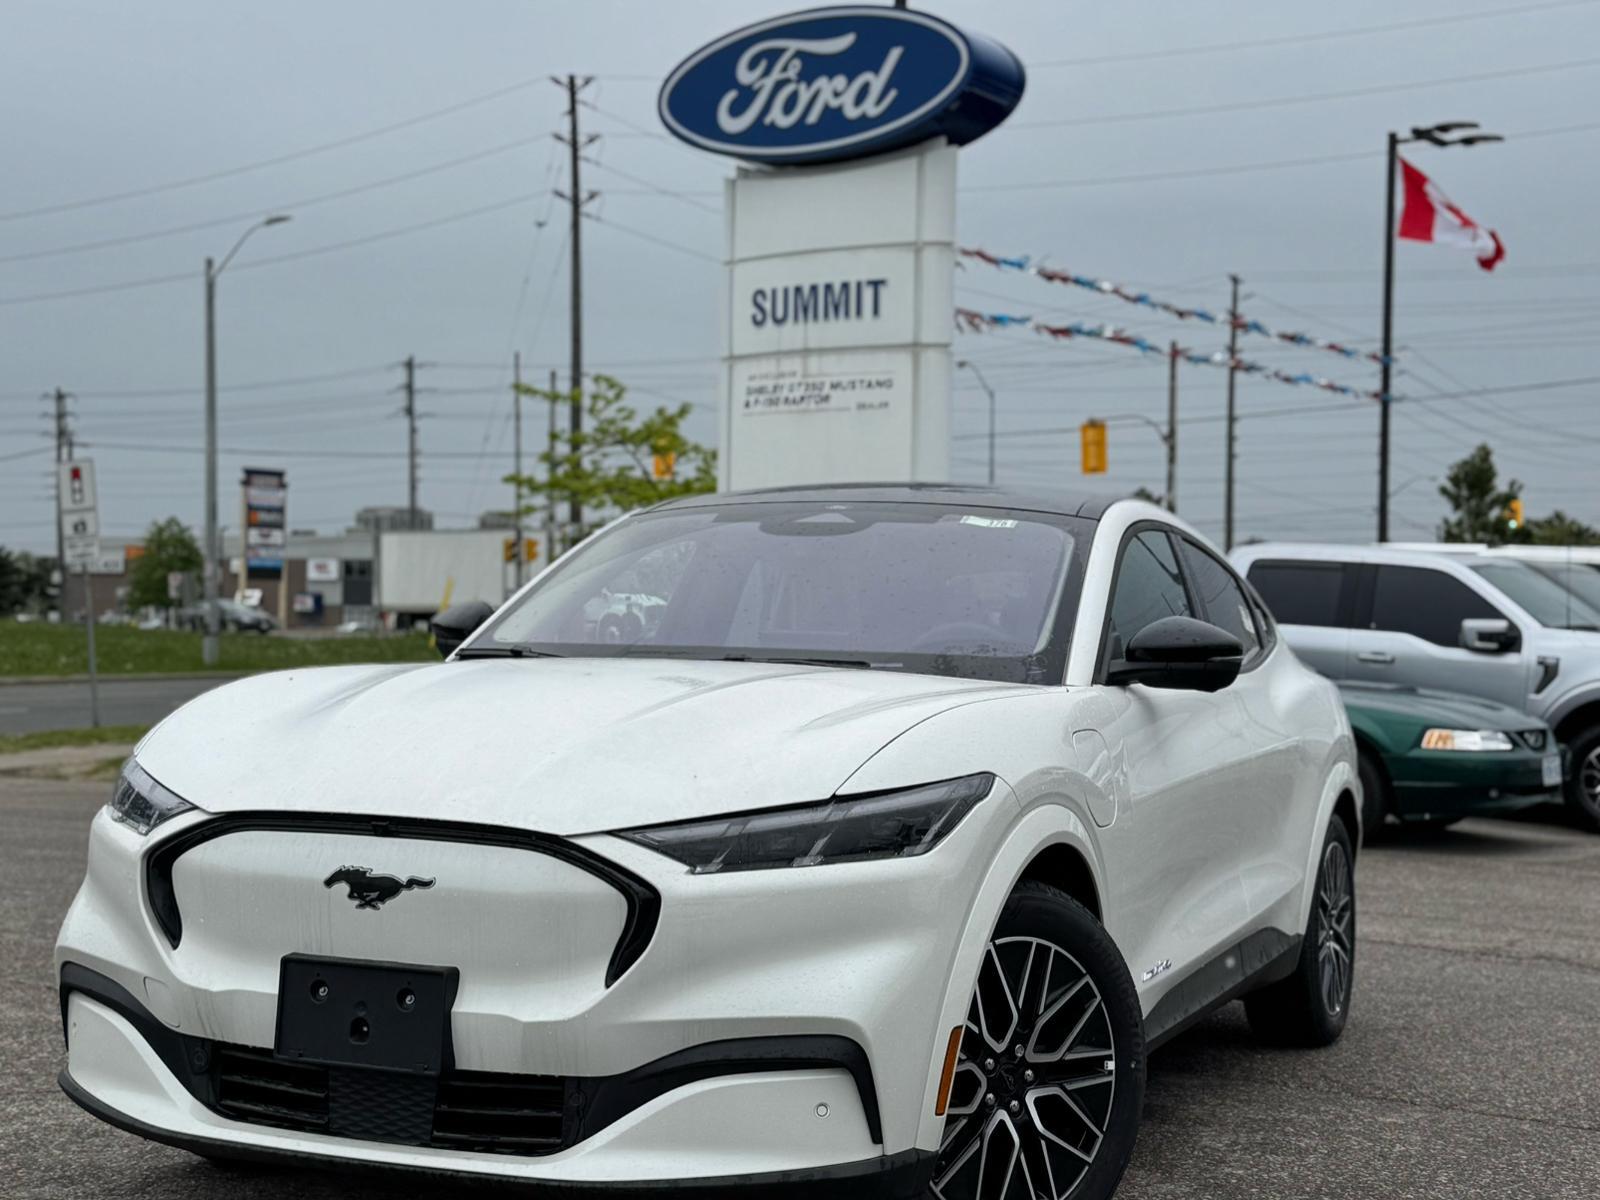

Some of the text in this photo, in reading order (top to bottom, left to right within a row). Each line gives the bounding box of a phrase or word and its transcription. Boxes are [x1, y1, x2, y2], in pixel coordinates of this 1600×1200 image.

[716, 32, 904, 135] Ford
[751, 278, 888, 328] SUMMIT
[829, 378, 894, 392] MUSTANG
